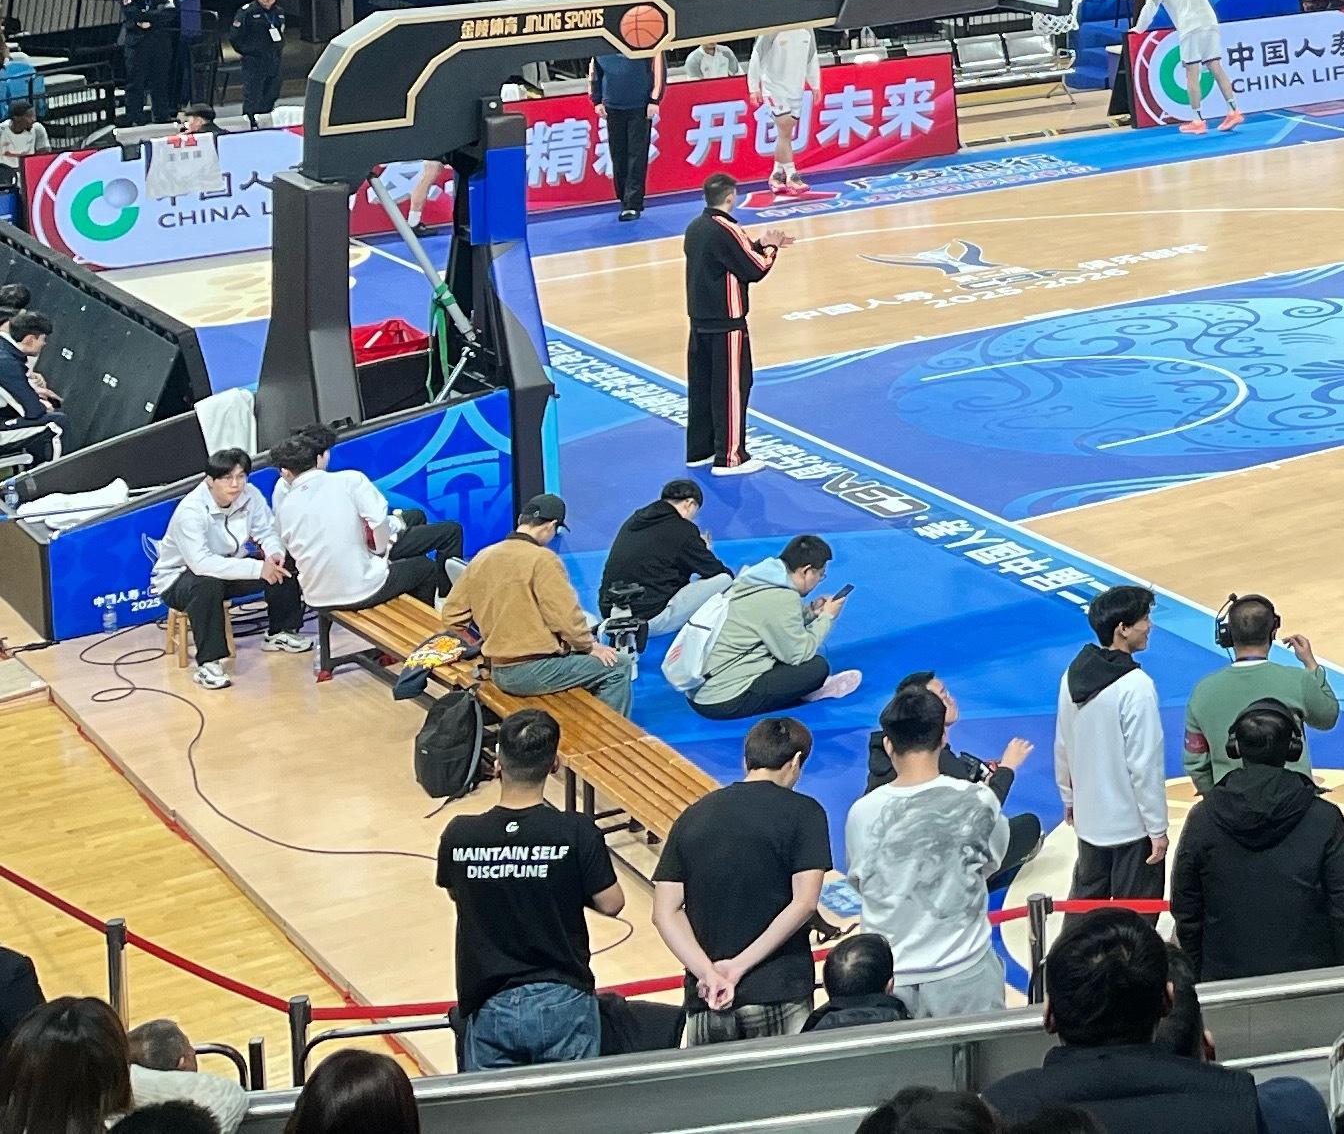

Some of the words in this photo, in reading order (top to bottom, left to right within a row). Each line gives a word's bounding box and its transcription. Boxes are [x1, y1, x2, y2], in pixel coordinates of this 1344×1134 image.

[564, 8, 604, 29] SPORTS
[1232, 71, 1305, 94] CHINA
[157, 203, 251, 228] CHINA
[924, 267, 1130, 310] 2025-2026
[530, 845, 570, 861] SELF
[466, 864, 549, 879] DISCIPLINE
